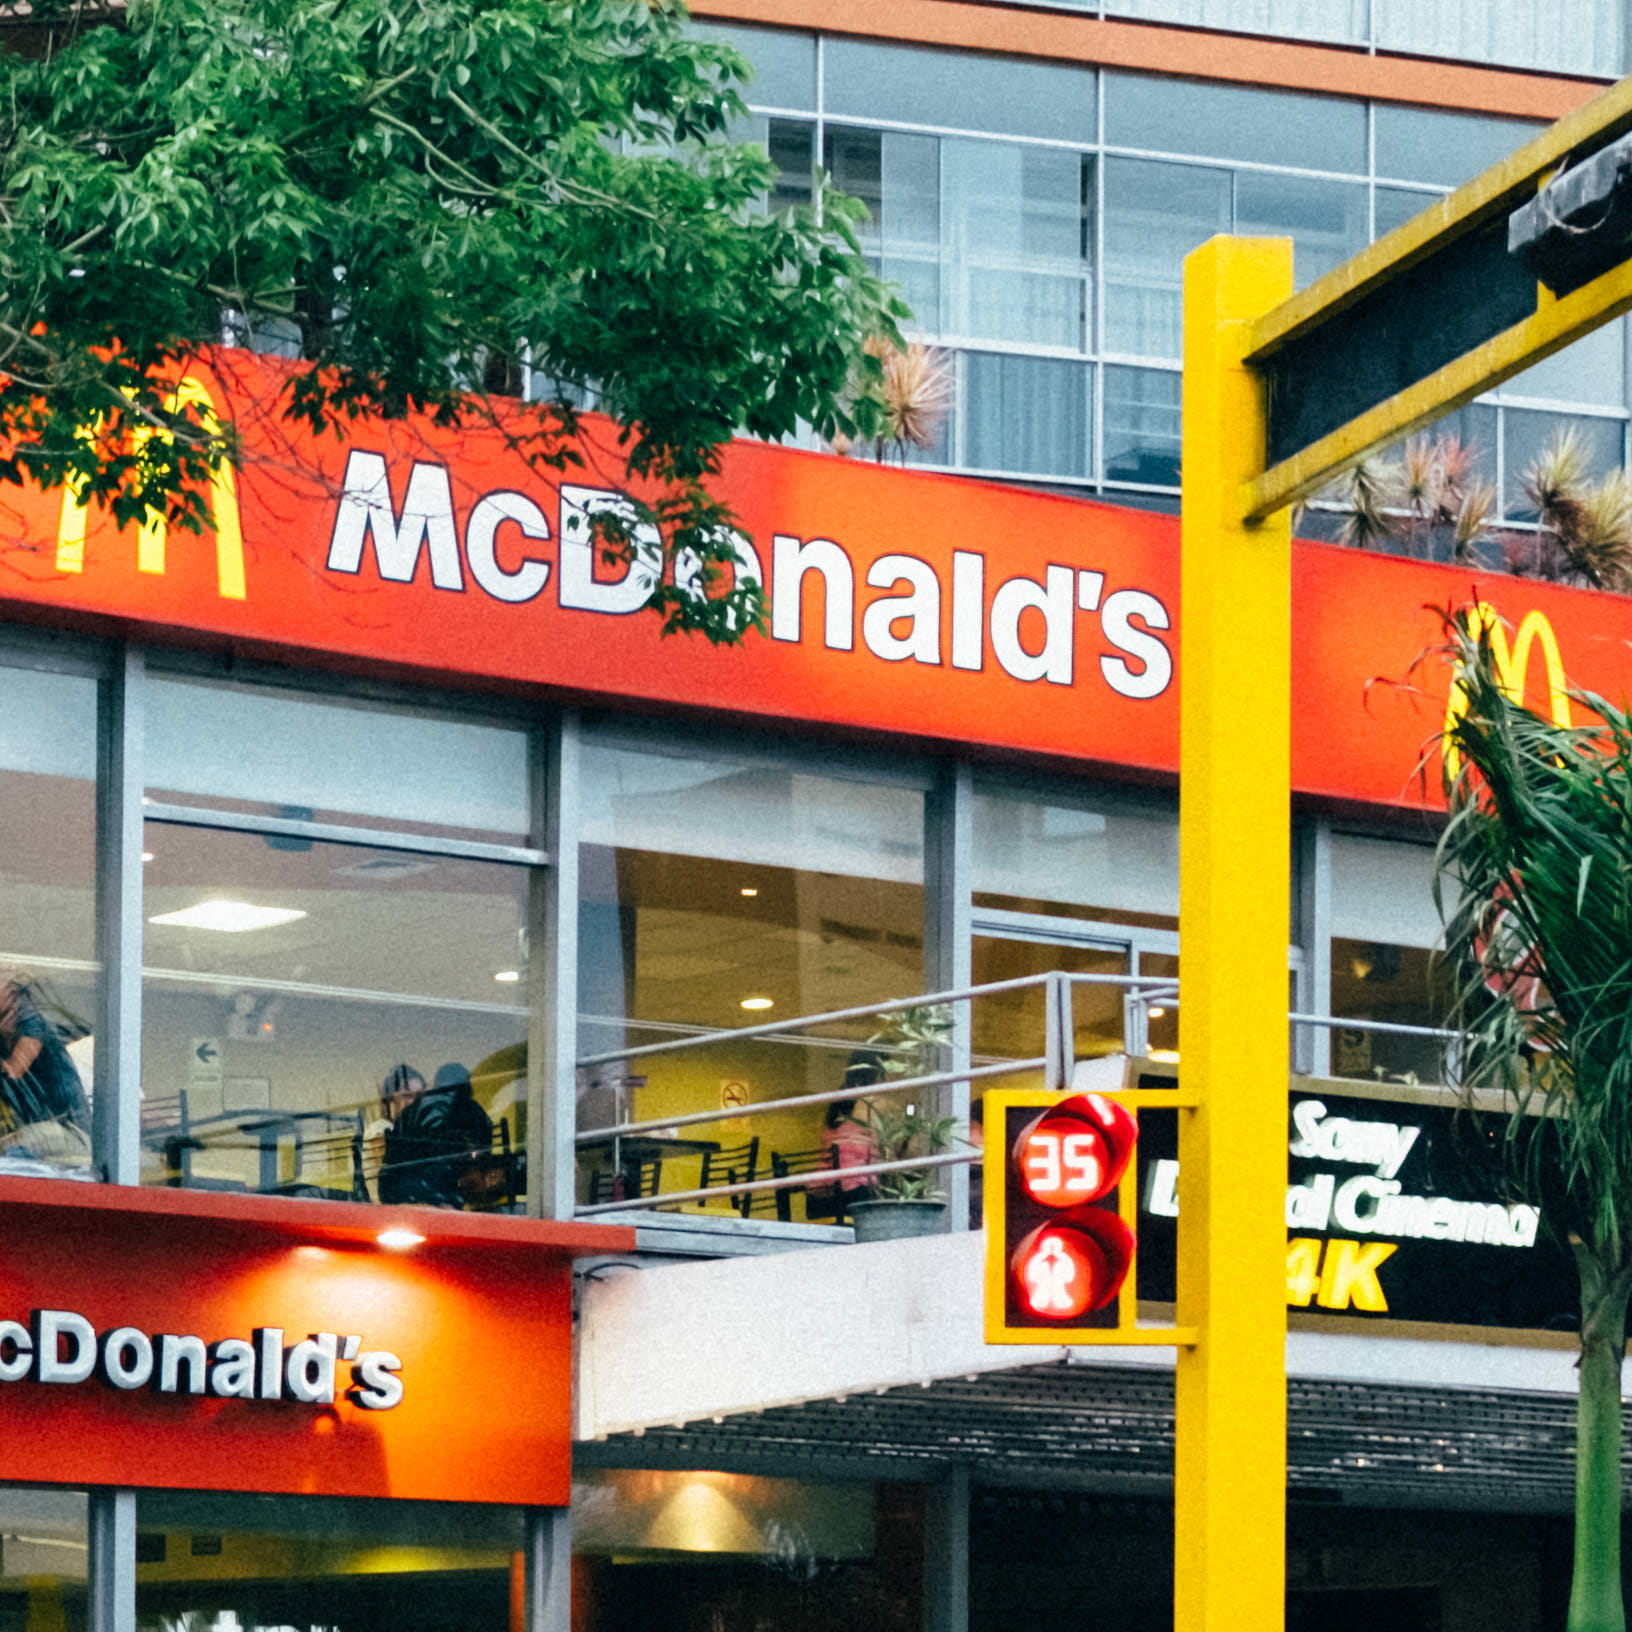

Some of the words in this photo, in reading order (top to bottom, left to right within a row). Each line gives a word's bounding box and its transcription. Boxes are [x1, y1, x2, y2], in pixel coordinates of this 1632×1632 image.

[1028, 1135, 1098, 1191] 35
[1290, 1100, 1420, 1179] Sony
[1334, 1176, 1540, 1248] Cinema
[1286, 1239, 1399, 1312] 4K
